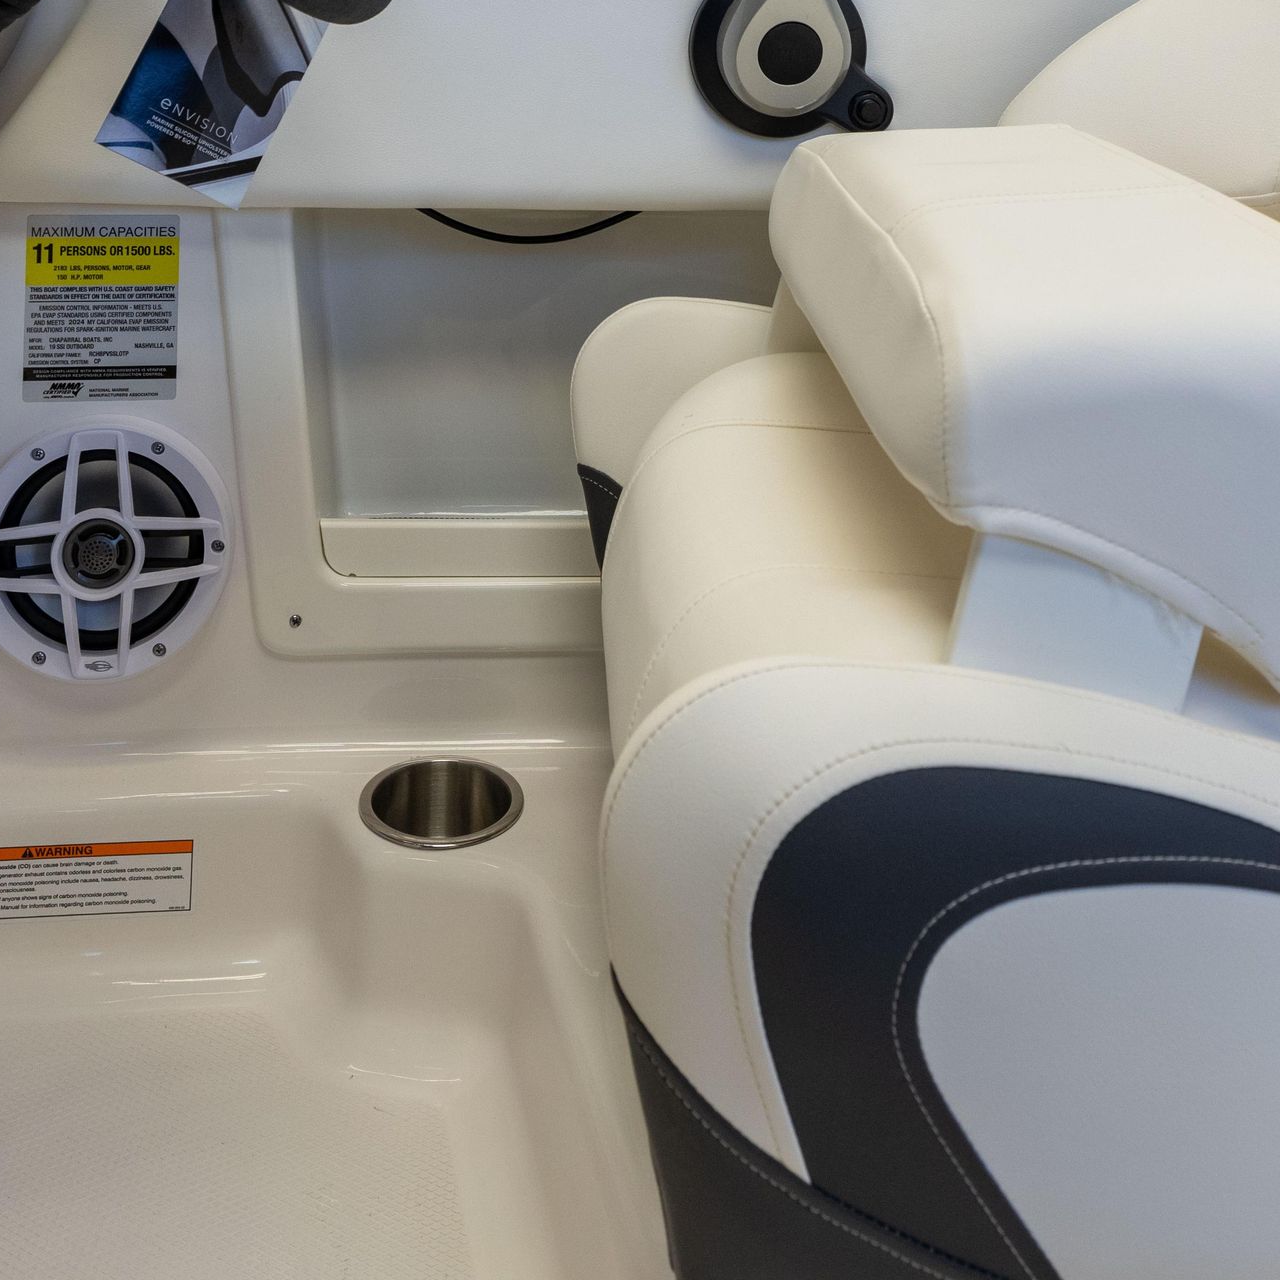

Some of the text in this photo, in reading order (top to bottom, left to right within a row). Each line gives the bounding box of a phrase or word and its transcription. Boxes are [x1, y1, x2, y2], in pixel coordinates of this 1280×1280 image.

[151, 115, 176, 129] MARINE
[174, 125, 199, 141] SILICONE
[146, 119, 175, 137] POWERED
[174, 133, 182, 141] BY
[196, 144, 228, 162] TECHNOLO
[31, 226, 176, 237] MAXIMUM CAPACITIES
[32, 243, 53, 264] 11
[60, 246, 175, 256] PERSONS OR 1500 LBS.
[36, 846, 92, 856] WARNING
